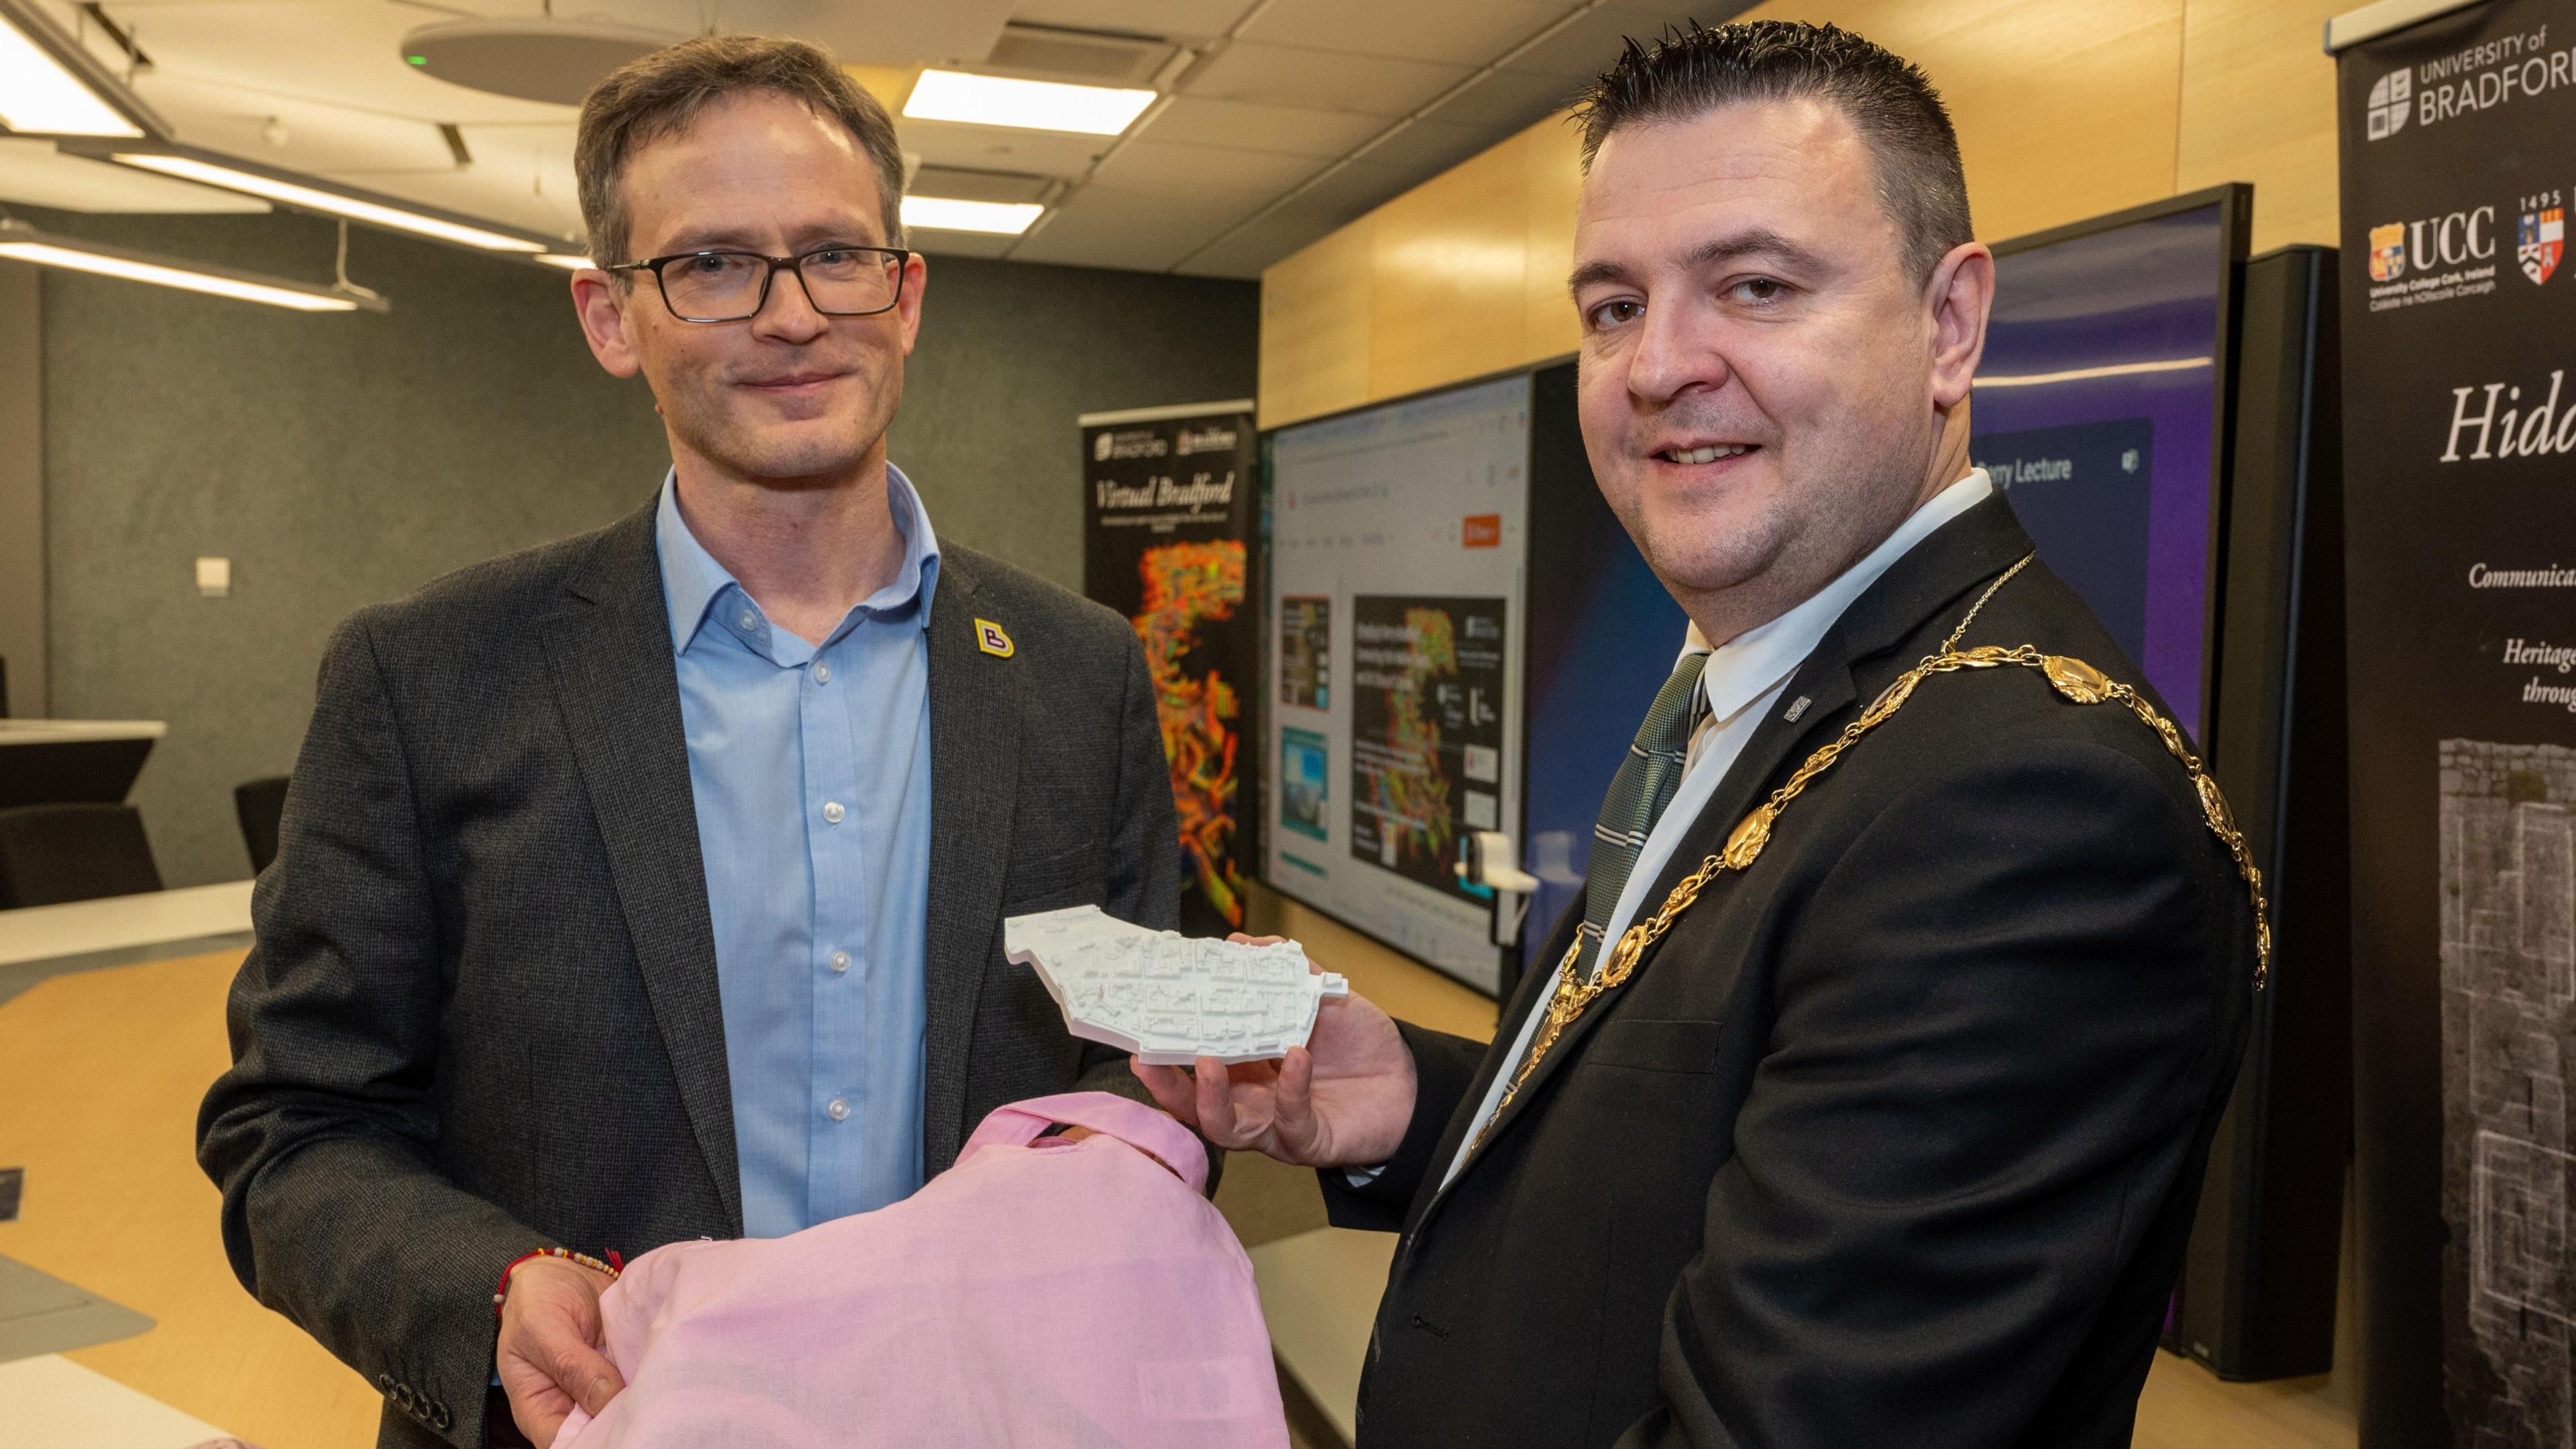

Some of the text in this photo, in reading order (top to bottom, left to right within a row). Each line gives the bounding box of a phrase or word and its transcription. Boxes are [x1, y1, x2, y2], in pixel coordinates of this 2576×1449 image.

[2420, 23, 2547, 84] UNIVERSITY of
[2420, 46, 2576, 126] BRADFOR
[2520, 189, 2561, 212] 1495
[2410, 205, 2495, 270] UCC
[2409, 277, 2440, 291] College
[1976, 458, 2073, 490] erry Lecture
[1157, 470, 1235, 515] Bradford
[2469, 562, 2576, 588] Communica
[2503, 639, 2576, 673] Heritage
